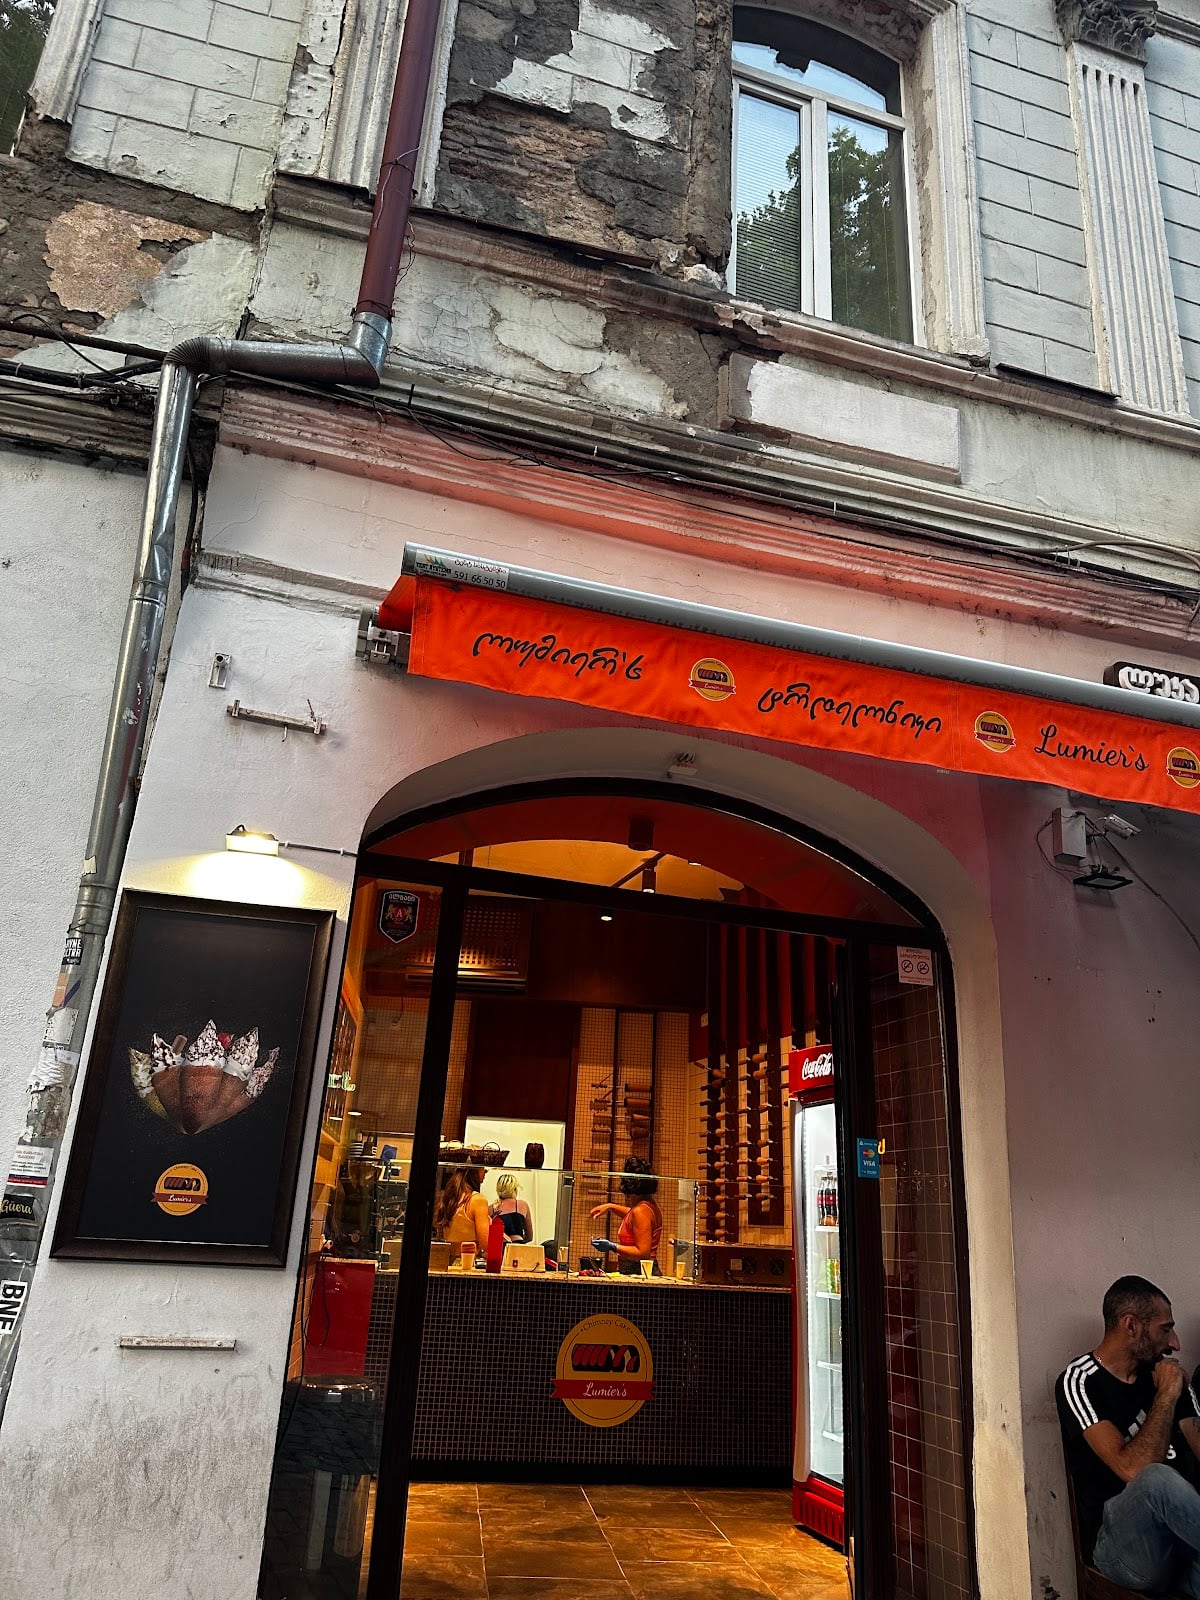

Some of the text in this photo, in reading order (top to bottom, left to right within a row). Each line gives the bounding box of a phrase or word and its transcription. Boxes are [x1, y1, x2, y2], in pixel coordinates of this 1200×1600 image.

[454, 570, 468, 581] 591
[471, 574, 482, 584] 66
[482, 576, 494, 586] 50
[495, 578, 506, 589] 50
[757, 682, 942, 738] ტრდელნიკი
[863, 1159, 876, 1167] VISA
[583, 1381, 627, 1398] Lumier's
